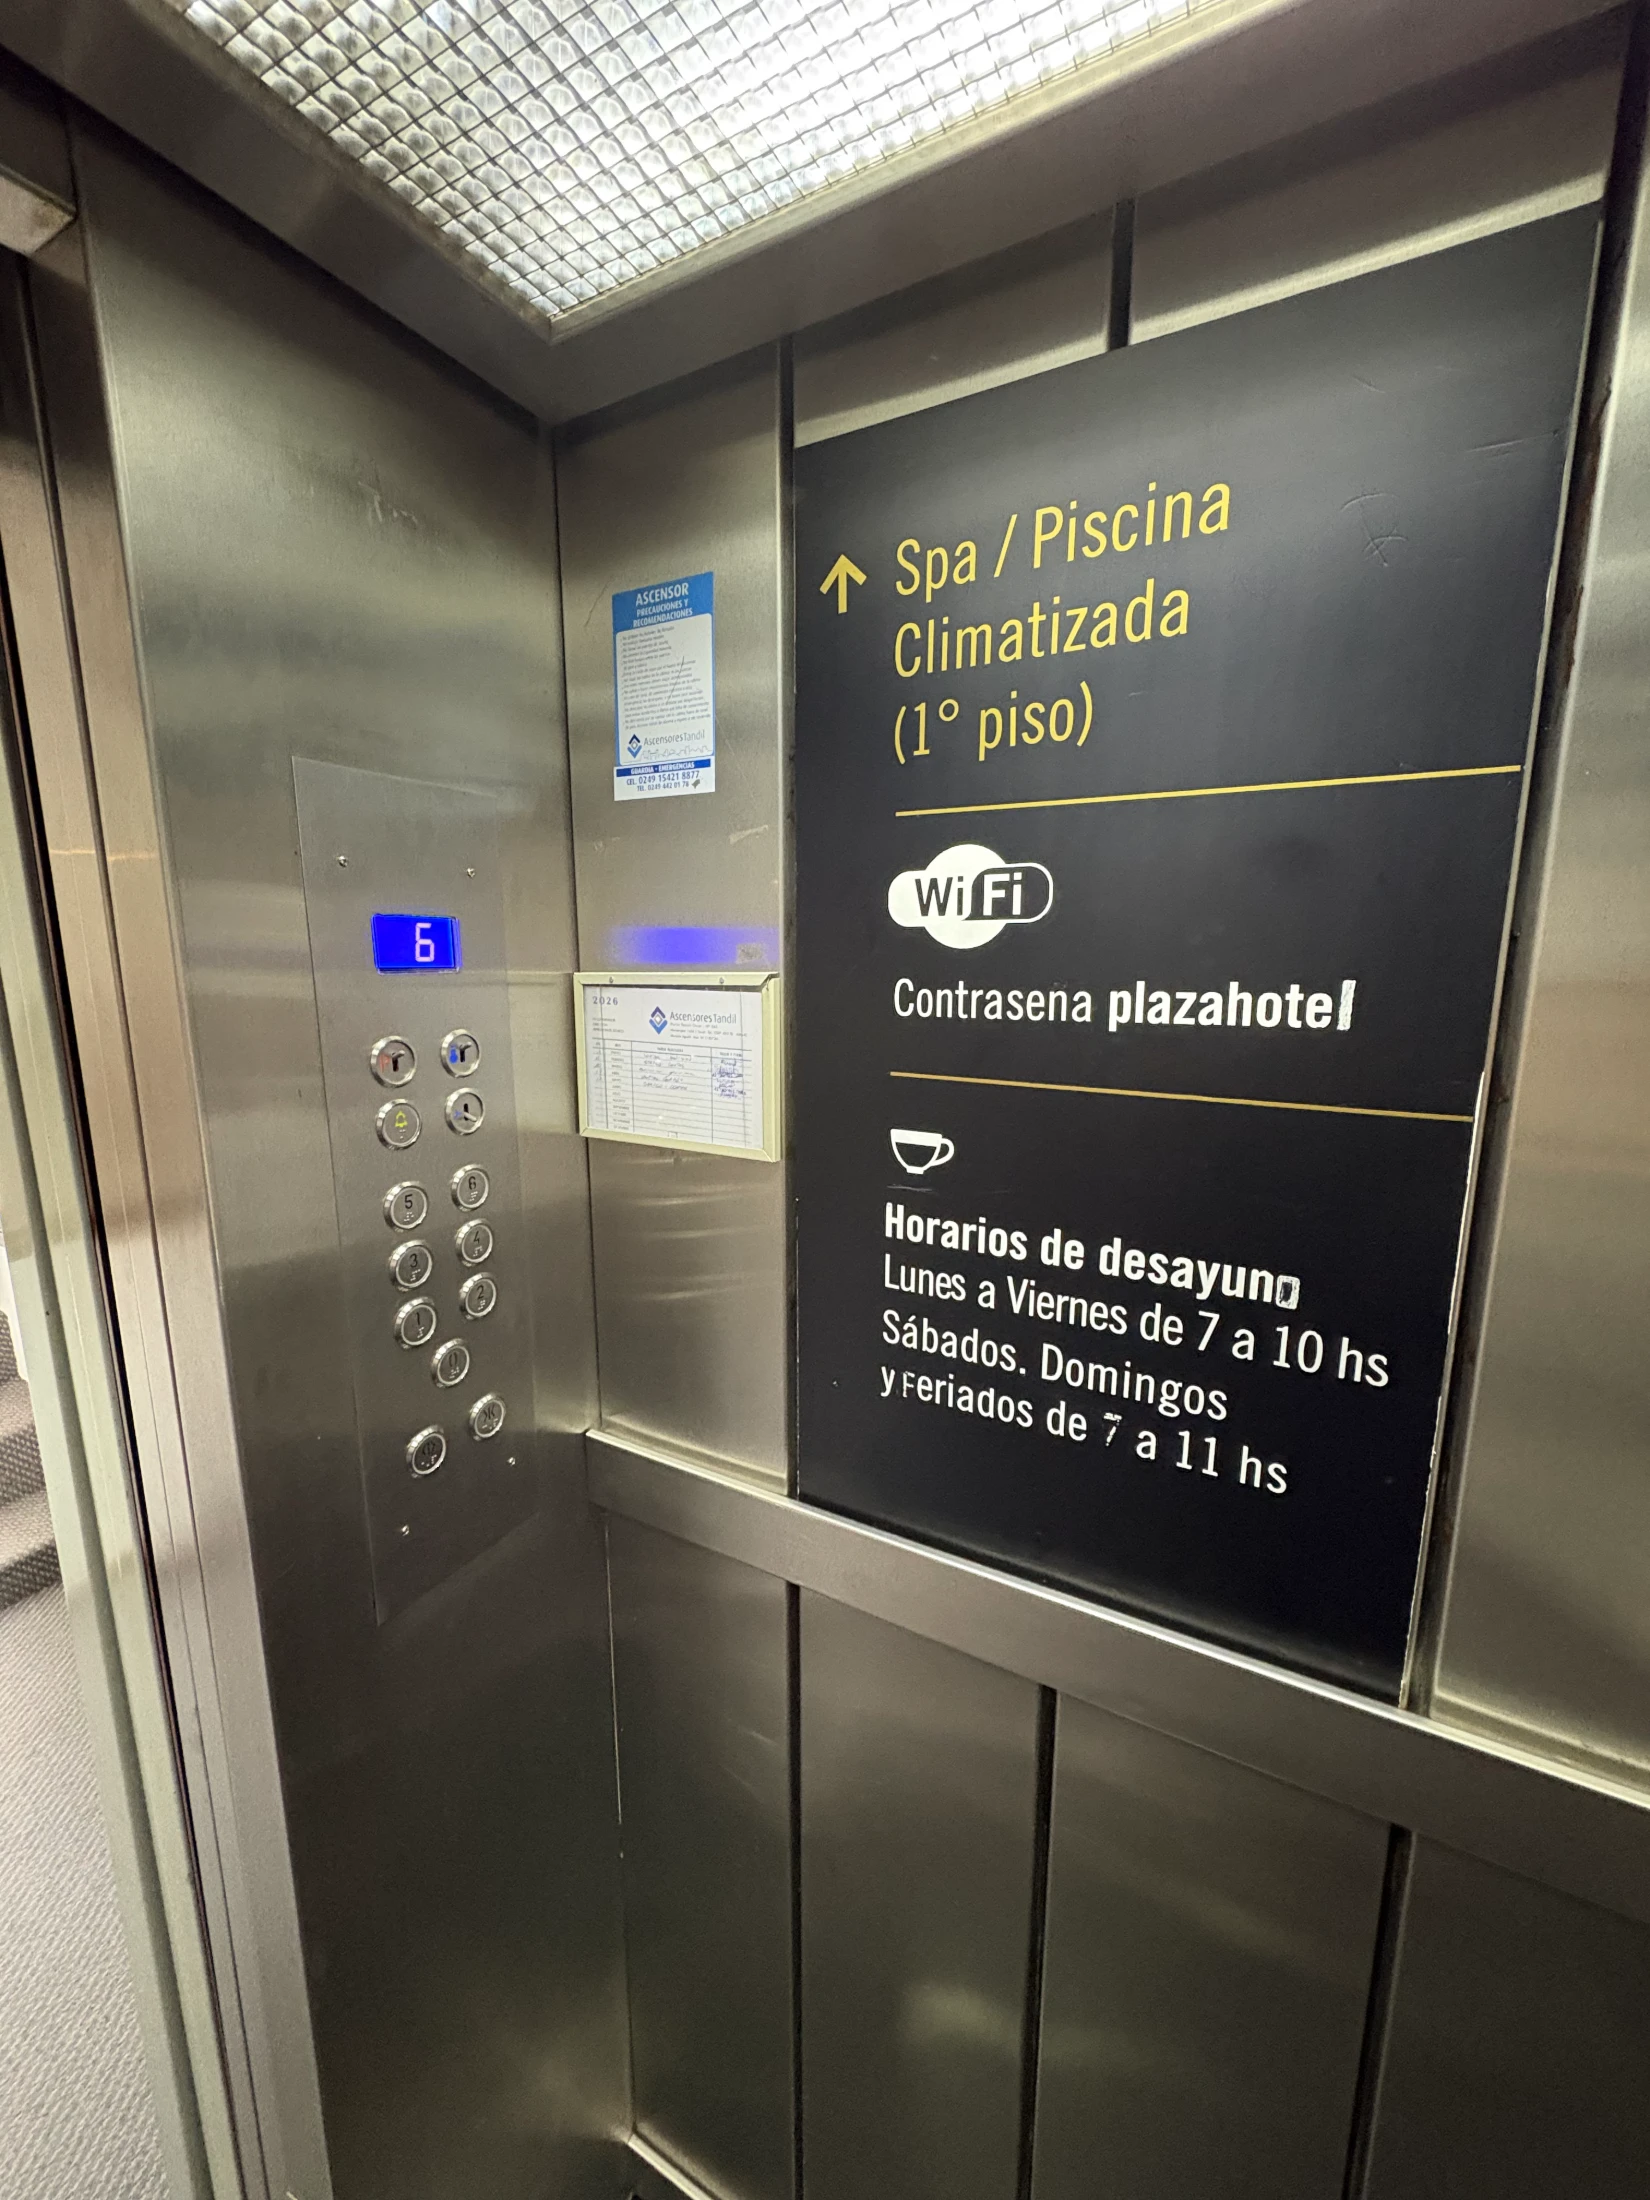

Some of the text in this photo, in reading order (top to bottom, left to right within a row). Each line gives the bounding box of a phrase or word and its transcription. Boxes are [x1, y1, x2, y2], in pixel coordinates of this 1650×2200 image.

[896, 481, 1231, 603] Spa / Piscina
[636, 582, 689, 606] ASCENSOR
[633, 607, 693, 628] RECOMENDACIONES
[636, 598, 689, 617] PRECAUCIONES Y
[895, 577, 1189, 678] Climatizada
[979, 681, 1093, 762] piso)
[631, 761, 695, 775] GUARDIA EMERGENCIAS
[638, 774, 656, 785] 0249
[658, 772, 679, 783] 15421
[681, 770, 700, 780] 8877
[414, 921, 435, 963] 6
[591, 995, 619, 1006] 2026
[1108, 979, 1357, 1032] plazahotel
[467, 1175, 477, 1191] 6
[404, 1193, 413, 1210] 5
[473, 1230, 480, 1245] 4
[409, 1252, 419, 1269] 3
[885, 1202, 1301, 1310] Horarios de desayuno
[476, 1284, 485, 1300] 2
[884, 1254, 1389, 1388] Lunes a Viernes de 7 a 10 hs
[1041, 1342, 1229, 1421] Domingos
[880, 1366, 896, 1398] y
[1046, 1400, 1087, 1442] de
[1102, 1412, 1123, 1447] 7
[1135, 1430, 1157, 1461] a
[1176, 1429, 1219, 1477] 11
[1239, 1445, 1288, 1494] hs
